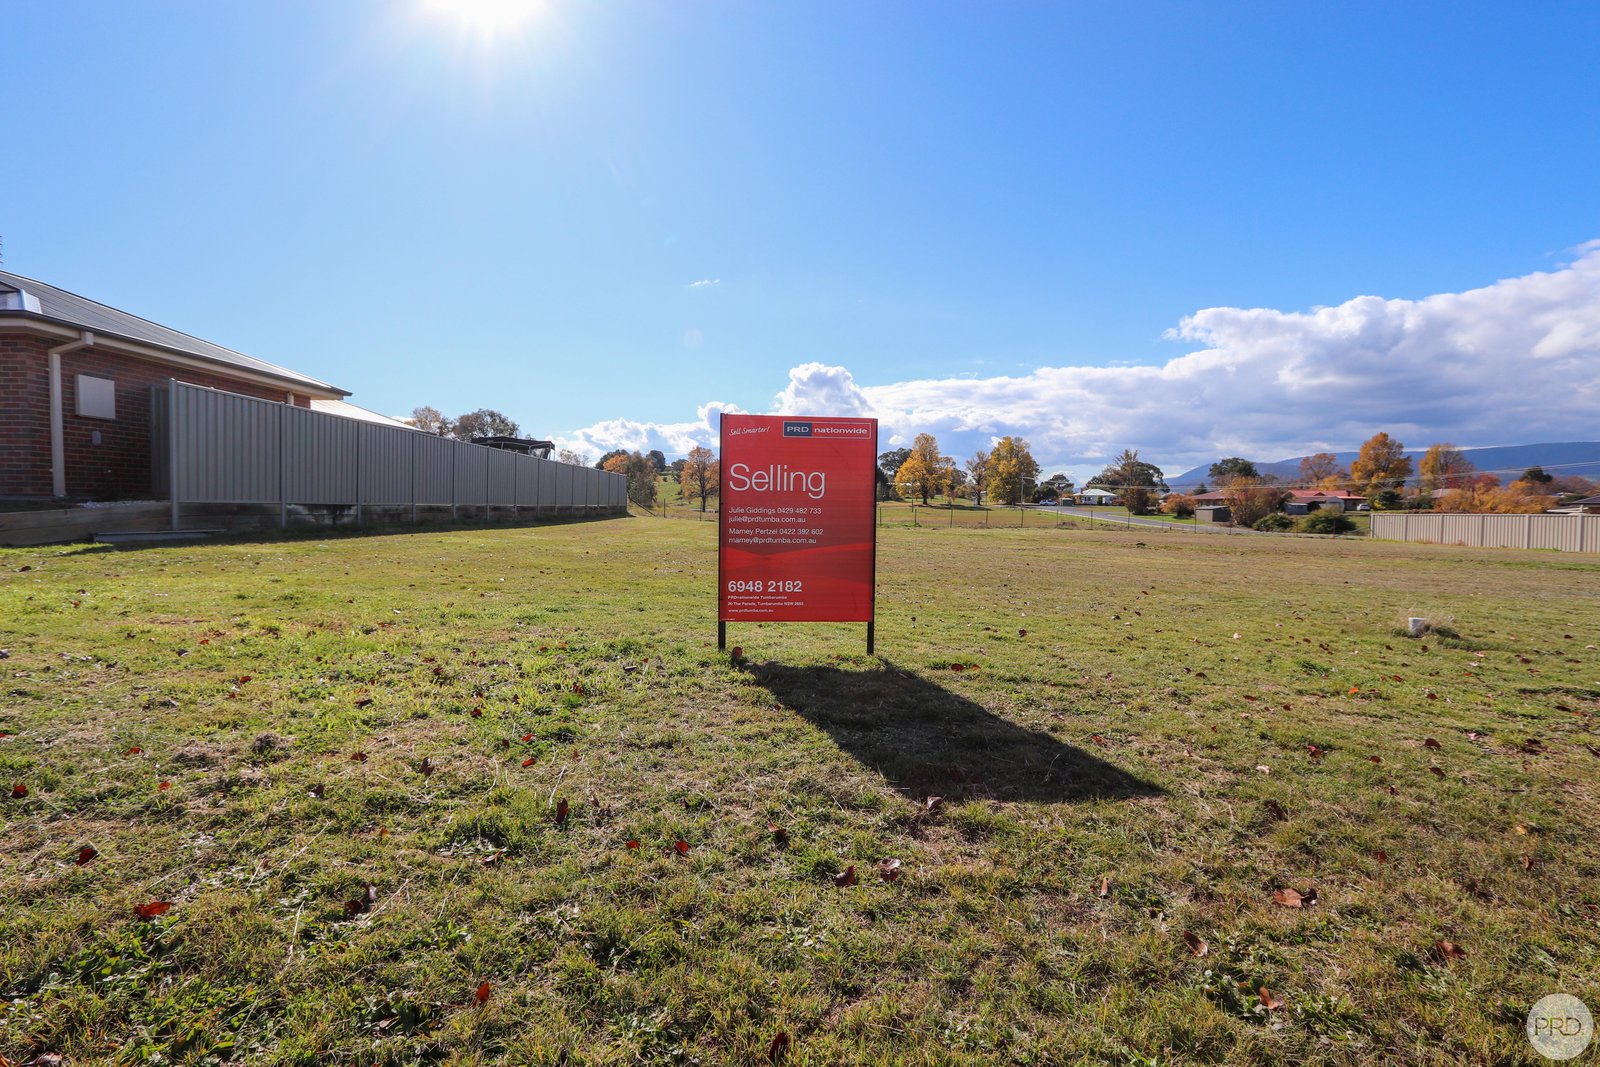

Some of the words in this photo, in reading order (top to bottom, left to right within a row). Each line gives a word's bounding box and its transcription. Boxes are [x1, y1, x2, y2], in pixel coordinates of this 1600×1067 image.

[729, 427, 744, 436] Sell
[742, 426, 770, 434] Smarter!
[814, 426, 868, 434] nationwide
[729, 463, 825, 499] Selling
[746, 507, 776, 515] Giddings
[728, 580, 763, 592] 6948
[768, 580, 802, 592] 2182
